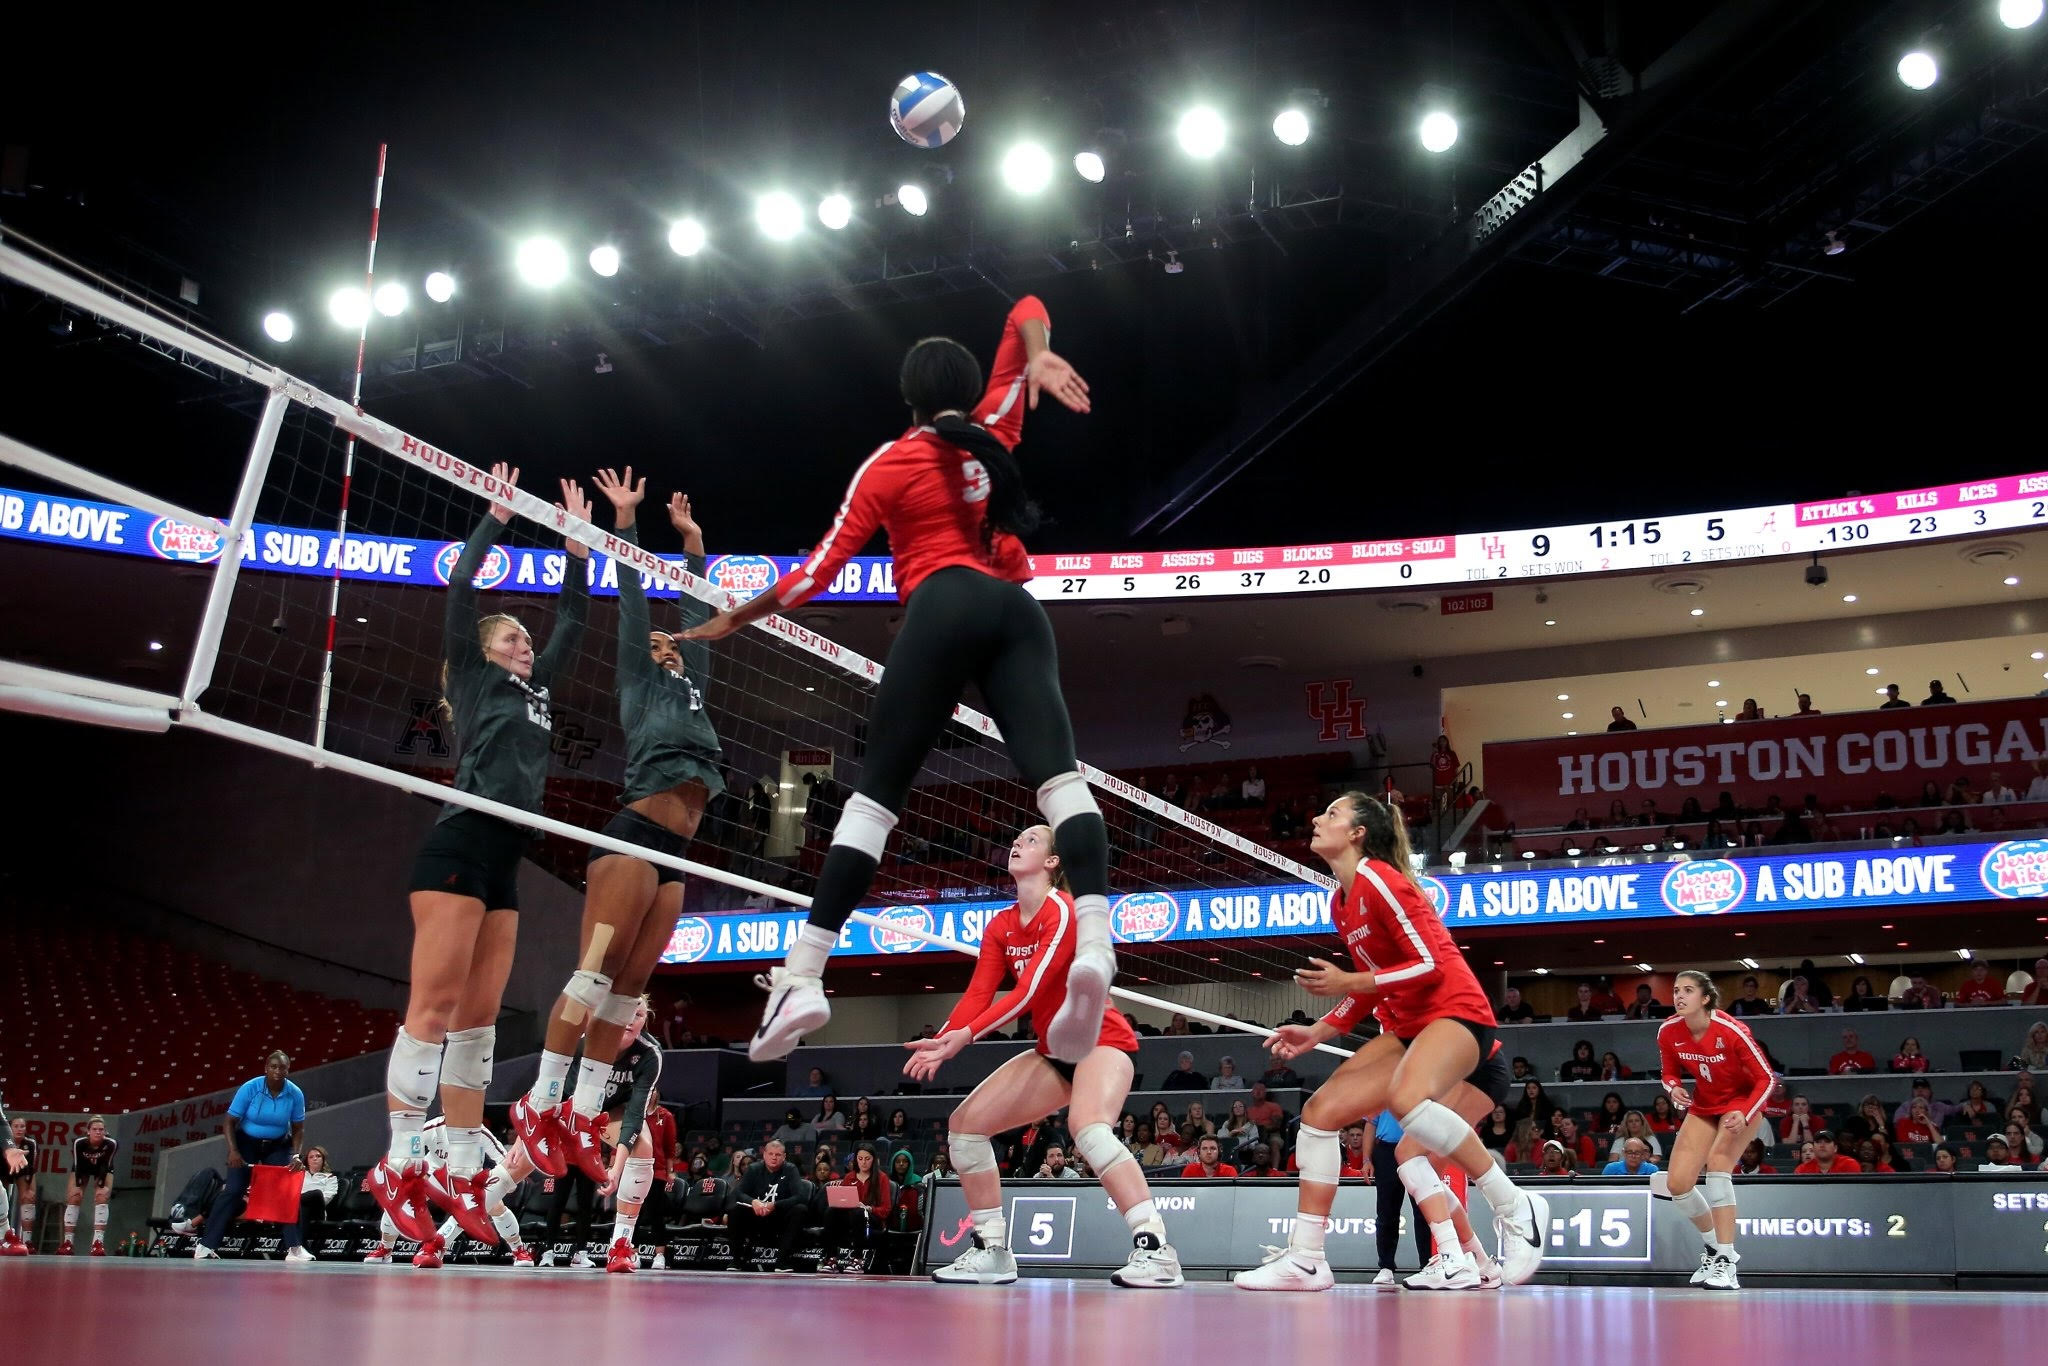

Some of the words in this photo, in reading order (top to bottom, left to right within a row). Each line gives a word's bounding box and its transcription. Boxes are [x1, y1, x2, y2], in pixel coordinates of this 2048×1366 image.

[401, 434, 516, 502] HOUSTON
[1801, 503, 1859, 521] ATTACK
[1861, 499, 1875, 514] %
[1896, 491, 1938, 510] KILLS
[1959, 483, 1998, 502] ACES
[28, 501, 125, 545] ABOVE
[1532, 534, 1551, 557] 9
[1590, 521, 1661, 548] 1:15
[1706, 518, 1725, 541] 5
[1819, 524, 1869, 543] .130
[1909, 516, 1938, 534] 23
[1973, 509, 1987, 526] 3
[2032, 501, 2048, 518] 2
[263, 531, 320, 567] SUB
[324, 538, 413, 576] ABOVE
[516, 553, 536, 584] A
[604, 533, 695, 589] HOUSTON
[1055, 555, 1091, 571] KILLS
[1109, 554, 1143, 570] ACES
[1161, 551, 1215, 568] ASSISTS
[1232, 549, 1264, 566] DIGS
[1282, 546, 1333, 562] BLOCKS
[1351, 542, 1403, 558] BLOCKS
[1412, 539, 1446, 554] SOLO
[1650, 553, 1674, 566] TOL
[1682, 550, 1691, 562] 2
[1701, 547, 1732, 561] SETS
[1736, 543, 1765, 557] WON
[718, 563, 768, 578] Jersey
[1062, 579, 1087, 593] 27
[1124, 577, 1135, 591] 5
[1175, 575, 1200, 590] 26
[1240, 572, 1266, 588] 37
[1298, 569, 1330, 585] 2.0
[1400, 564, 1412, 579] 0
[1466, 567, 1490, 580] TOL
[1498, 566, 1507, 577] 2
[1521, 564, 1551, 576] SETS
[1555, 560, 1583, 573] WON
[765, 613, 841, 658] HOUSTON
[1305, 680, 1367, 742] UH
[1557, 736, 1827, 796] HOUSTON
[1837, 717, 2048, 775] COUGA
[1103, 774, 1148, 804] HOUSTON
[1183, 811, 1223, 838] HOUSTON
[1994, 851, 2048, 870] Jerse
[1313, 871, 1341, 890] HOUSTO
[1674, 870, 1732, 888] Jersey
[1756, 864, 1778, 902] A
[1783, 863, 1844, 900] SUB
[1852, 854, 1955, 897] ABOVE
[2000, 866, 2048, 888] Mike
[1119, 901, 1170, 919] Jersey
[1457, 883, 1477, 918] A
[1483, 879, 1539, 917] SUB
[1545, 873, 1639, 914] ABOVE
[941, 911, 959, 941] A
[1186, 898, 1204, 932] A
[1209, 895, 1261, 930] SUB
[1266, 891, 1336, 928] ABOV
[717, 923, 732, 954] A
[737, 920, 778, 951] SUB
[1678, 1051, 1726, 1063] HOUSTON
[1155, 1196, 1196, 1211] WON
[1993, 1192, 2048, 1209] SETS
[1028, 1212, 1055, 1247] 5
[1552, 1208, 1632, 1248] :15
[1737, 1217, 1871, 1236] TIMEOUTS:
[1887, 1214, 1905, 1236] 2
